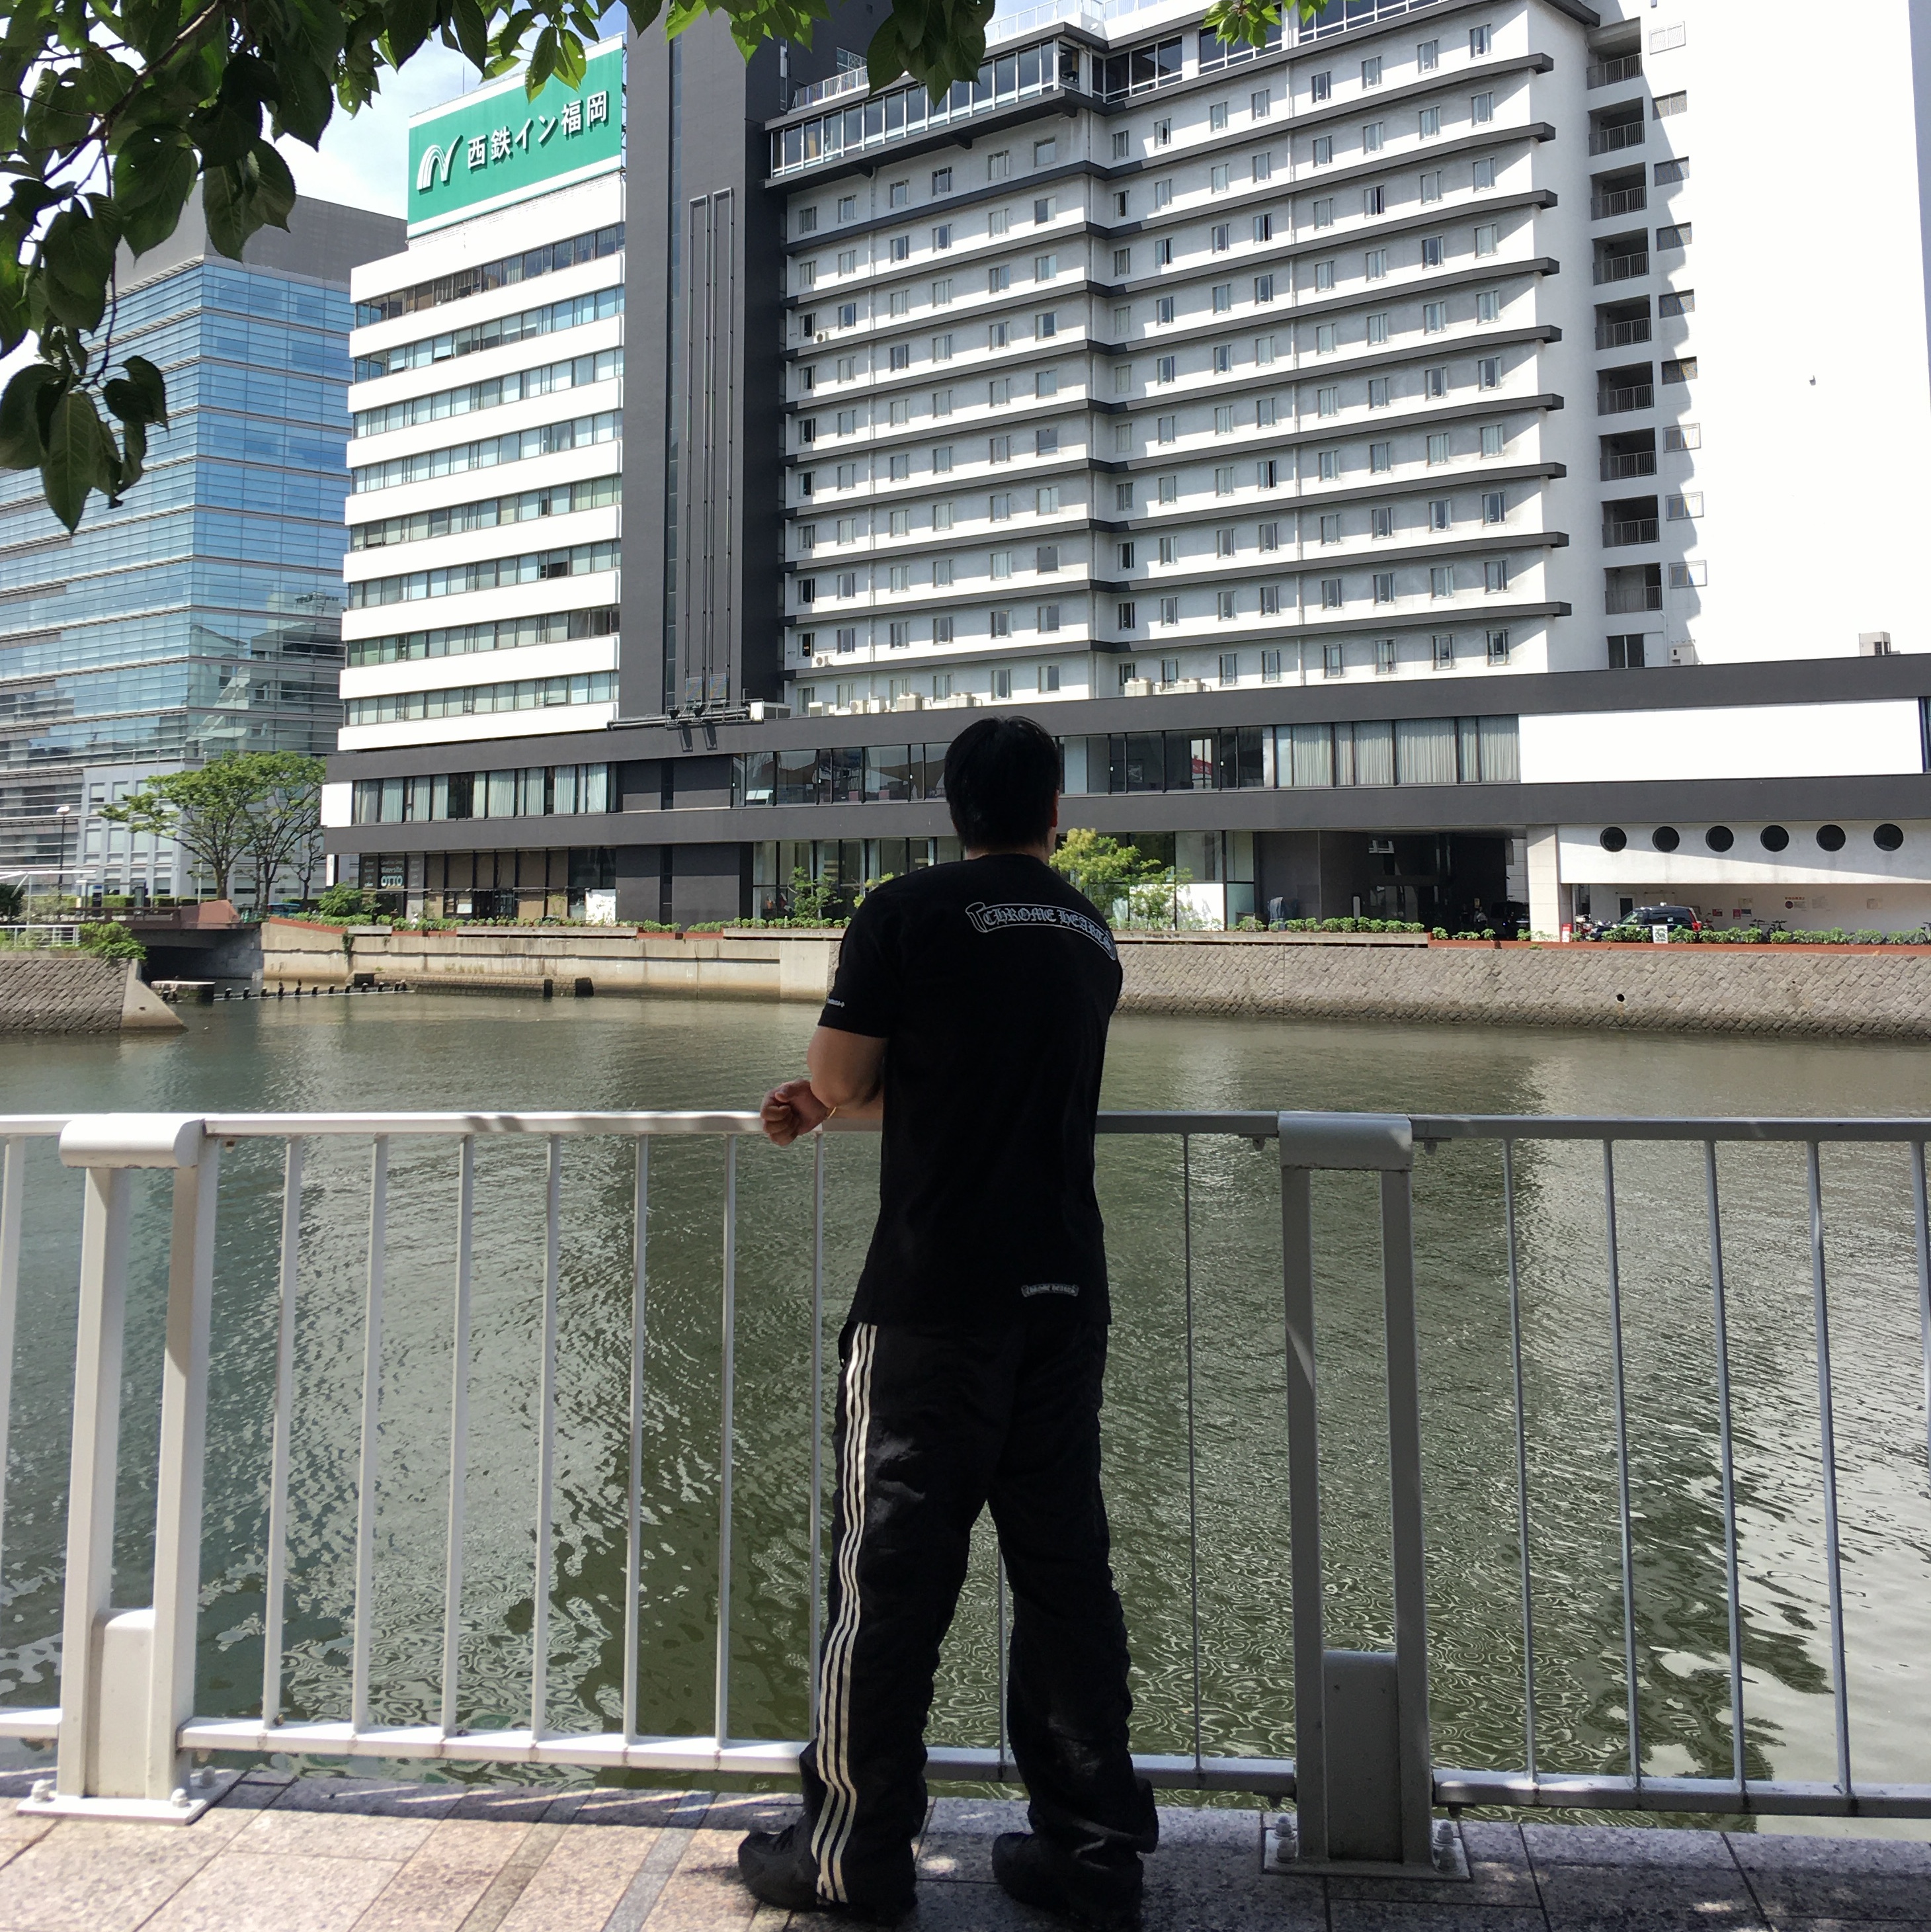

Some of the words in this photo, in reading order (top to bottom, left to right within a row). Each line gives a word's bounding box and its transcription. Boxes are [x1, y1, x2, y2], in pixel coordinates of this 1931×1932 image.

[467, 90, 608, 169] 西鉄イン福岡
[380, 875, 403, 887] OTTO
[983, 907, 1057, 926] CHROME
